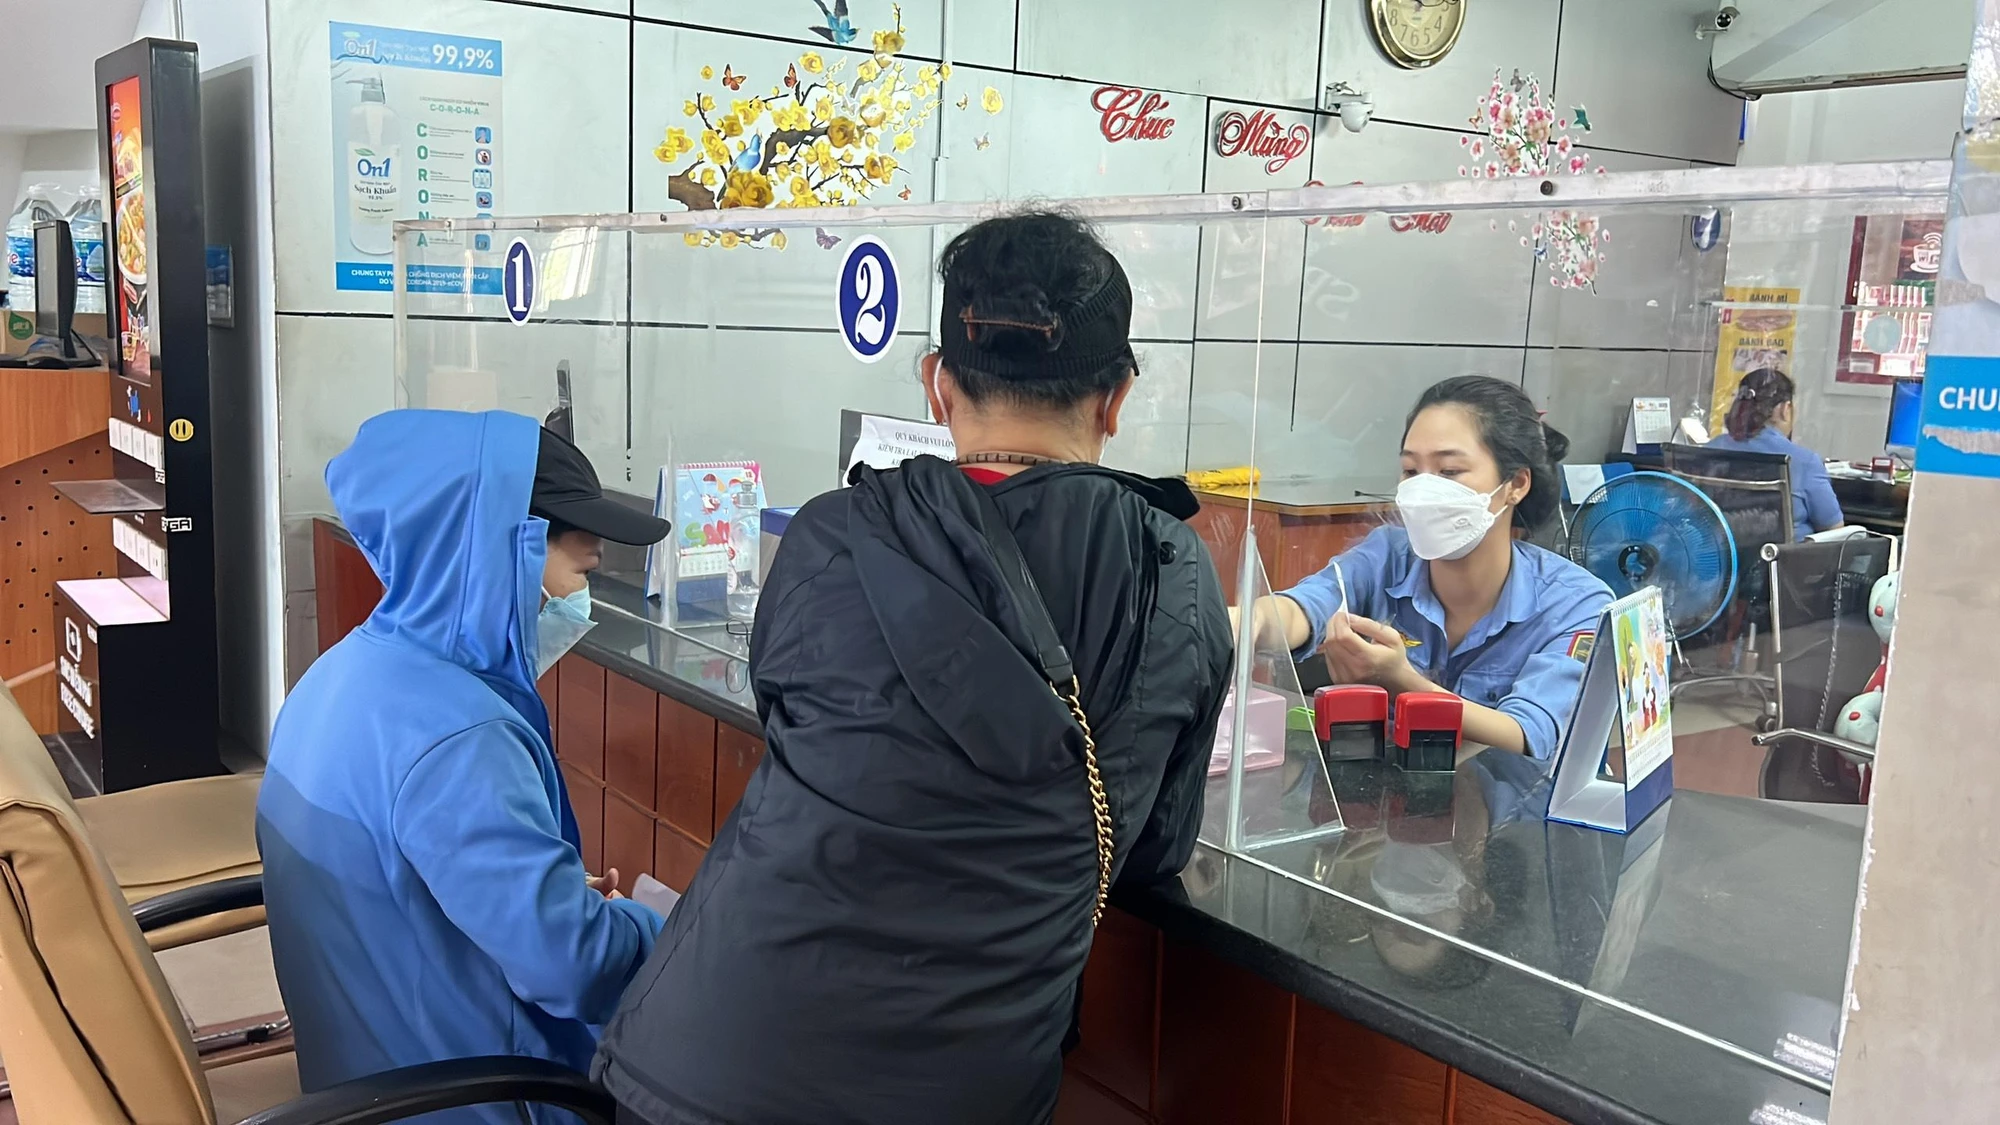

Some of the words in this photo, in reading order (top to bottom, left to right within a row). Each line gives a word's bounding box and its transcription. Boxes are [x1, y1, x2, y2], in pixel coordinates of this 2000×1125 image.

[1390, 8, 1398, 27] 8
[1434, 15, 1442, 33] 4
[1400, 23, 1408, 42] 7
[1410, 29, 1419, 47] 6
[1423, 27, 1431, 45] 5
[432, 43, 494, 70] 99,9%
[1091, 85, 1175, 143] Chúc
[357, 157, 391, 178] On1
[351, 268, 374, 277] CHUNG
[374, 269, 386, 277] TAY
[511, 249, 528, 312] 1
[855, 254, 886, 345] 2
[942, 439, 955, 448] LÒN
